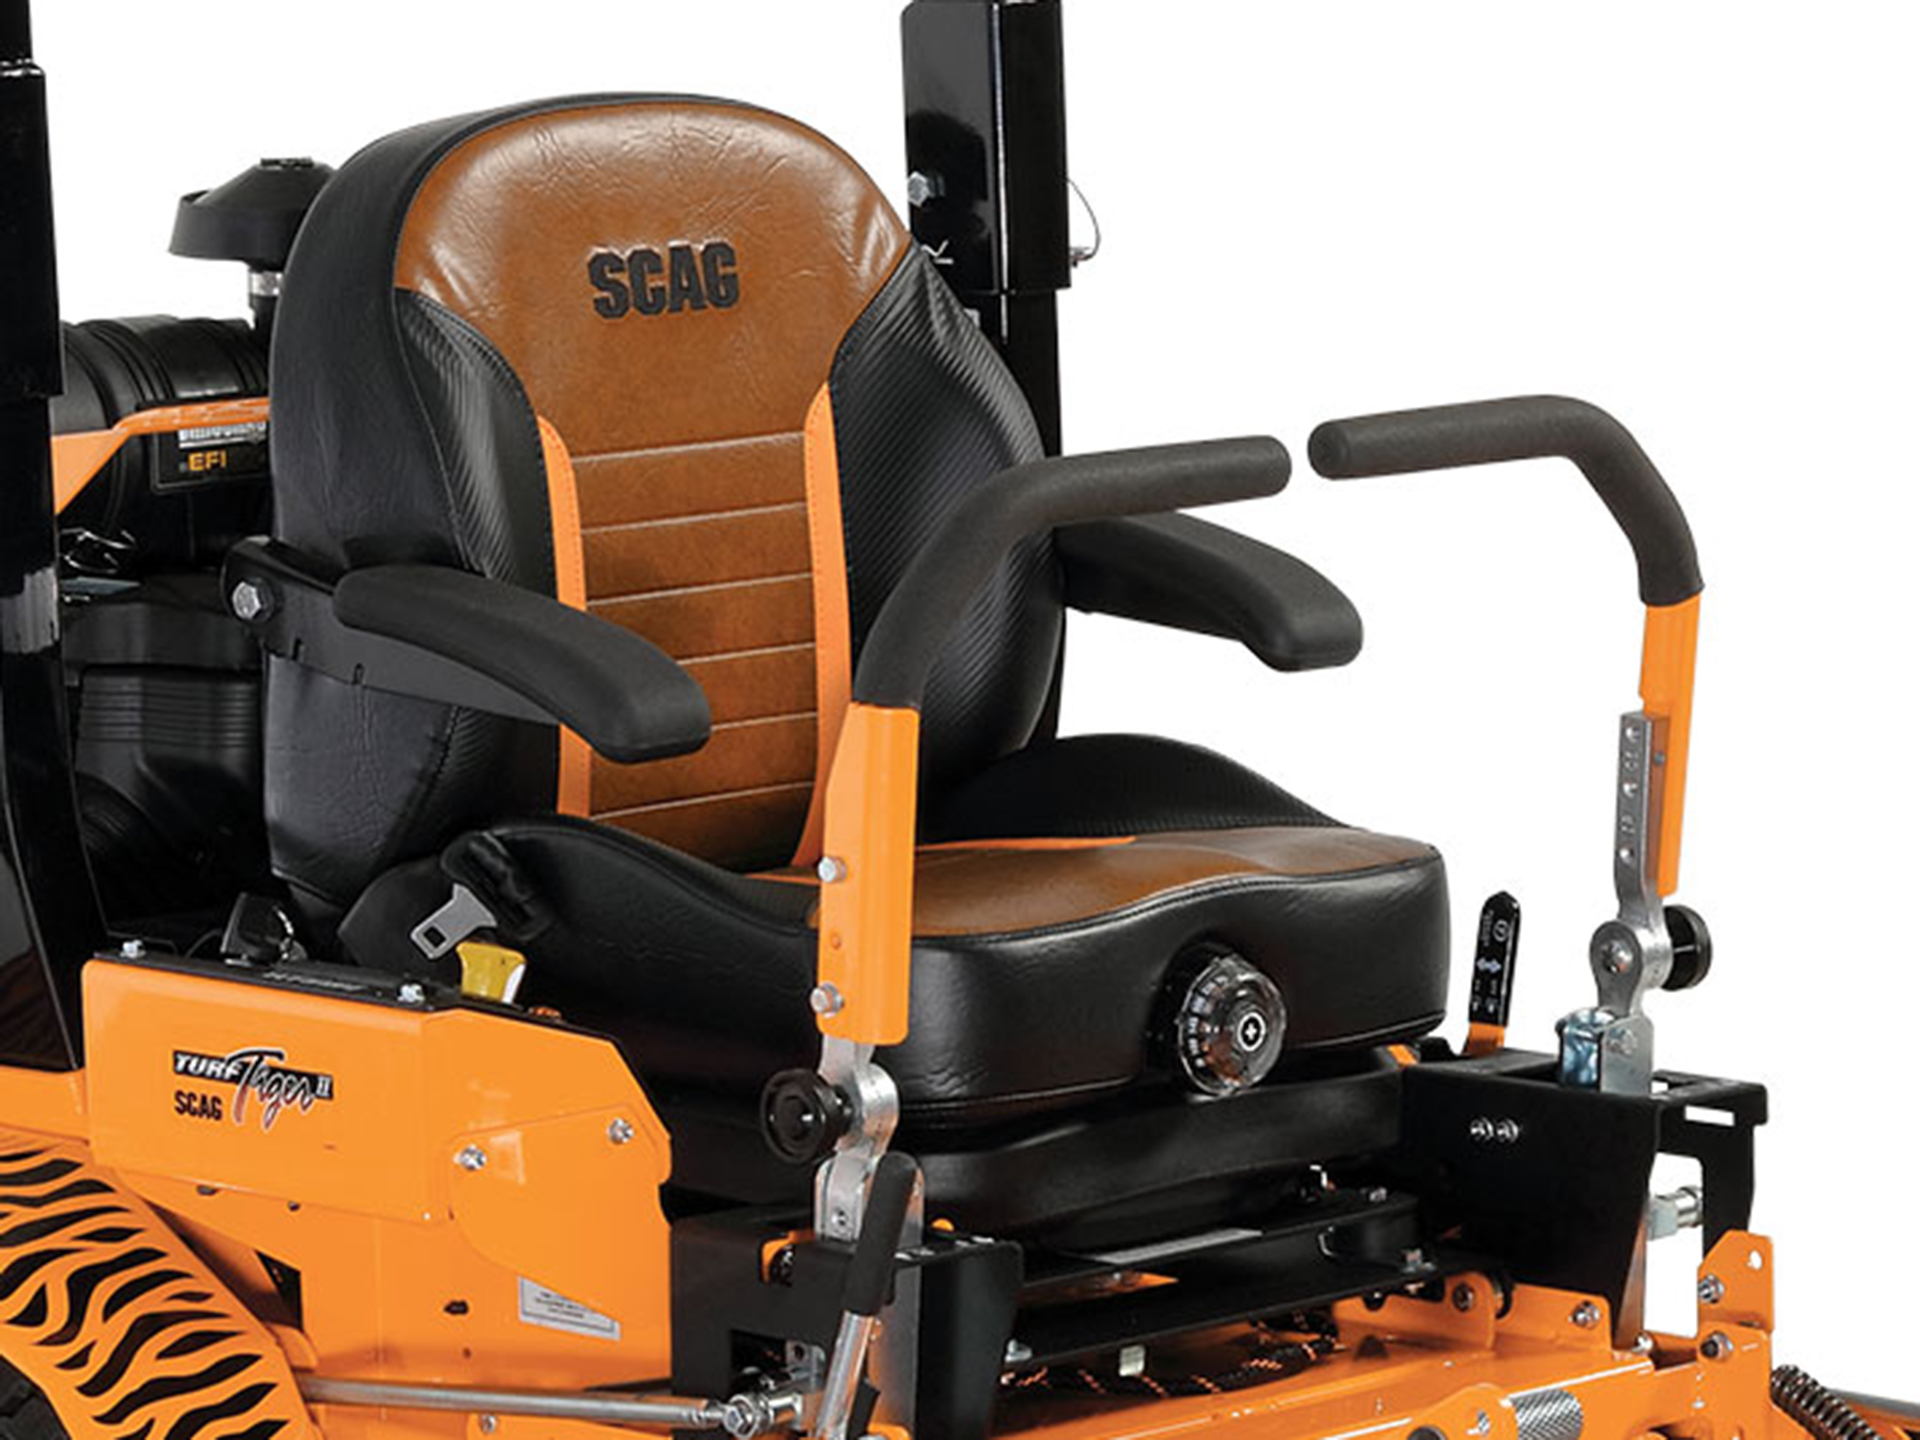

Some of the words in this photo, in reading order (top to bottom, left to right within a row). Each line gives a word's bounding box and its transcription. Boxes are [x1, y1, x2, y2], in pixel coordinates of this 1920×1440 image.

[587, 242, 740, 319] SCAG
[188, 450, 227, 471] EFI
[174, 1090, 223, 1121] SCAG
[175, 1053, 242, 1081] TURF
[224, 1047, 316, 1130] Tiger
